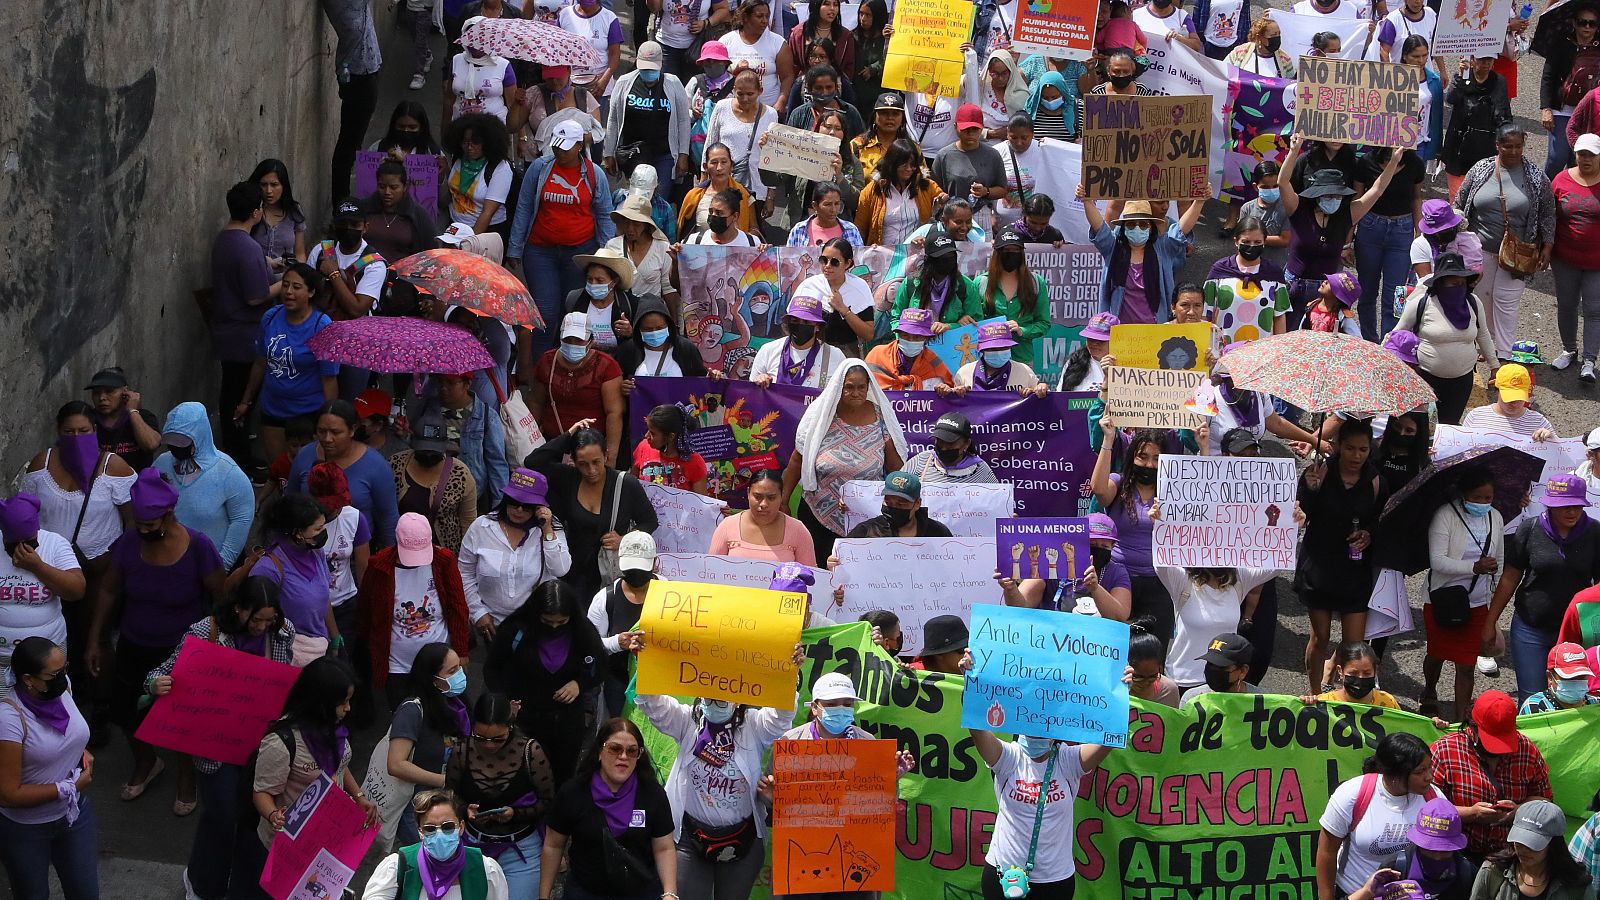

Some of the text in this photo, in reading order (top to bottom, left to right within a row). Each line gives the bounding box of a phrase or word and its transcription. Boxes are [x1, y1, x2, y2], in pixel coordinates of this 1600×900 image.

[943, 8, 954, 18] de
[919, 16, 946, 28] Integral
[1022, 18, 1060, 29] ¡CUMPLAN
[1061, 23, 1076, 31] CON
[1020, 34, 1069, 46] LAS MUJERES!
[1021, 26, 1089, 41] PRESUPUESTO PARA
[1146, 47, 1165, 58] rzo
[1149, 63, 1202, 86] de la Mujer
[1299, 57, 1328, 84] NO
[1335, 62, 1366, 85] HAY
[1317, 86, 1381, 113] BELLO
[1386, 92, 1419, 116] QUE
[1349, 113, 1419, 147] JUNTAS
[1083, 135, 1112, 163] HOY
[1115, 130, 1140, 164] NO
[1141, 128, 1171, 162] VOY
[1085, 163, 1207, 199] POR LA CALLE
[544, 191, 575, 204] PUMA
[1028, 252, 1104, 268] RANDO SOBE
[1060, 270, 1102, 285] Y SOLID
[1076, 285, 1100, 301] DER
[1064, 301, 1100, 319] DIGN
[1112, 367, 1205, 388] MARCHO HOY
[1113, 386, 1191, 402] con mis amigas
[1134, 399, 1180, 411] no marchar
[899, 420, 936, 434] eldía
[970, 421, 1045, 434] minamos
[1049, 419, 1063, 431] el
[1109, 409, 1203, 428] mañana POR ELLAS
[979, 440, 1046, 455] pesino y
[1557, 446, 1572, 455] que
[990, 456, 1074, 471] Soberanía
[1159, 459, 1296, 481] NO ESTOY ACEPTANDO
[843, 486, 980, 500] Este ecuerda que
[1001, 478, 1069, 492] nizamos
[1159, 481, 1296, 503] LAS COSAS QUE NO PUEDO
[951, 503, 988, 519] estamos
[1216, 504, 1260, 525] ESTOY
[1000, 524, 1085, 534] ¡NI UNA MENOS!
[1155, 524, 1294, 549] CAMBIANDO LAS COSAS
[893, 553, 908, 561] me
[916, 551, 955, 561] recuerda
[962, 554, 977, 566] que
[1156, 547, 1293, 568] QUE NO PUEDO ACEPTAR
[723, 572, 737, 581] me
[868, 572, 987, 592] muchas las que estamos
[0, 586, 52, 601] BRES
[660, 590, 712, 628] PAE
[900, 604, 915, 612] nos
[923, 599, 951, 612] faltan
[718, 614, 757, 639] para
[976, 617, 1120, 660] Ante la Violencia
[649, 627, 791, 673] todas es nuestro
[806, 636, 945, 713] tamos
[1001, 653, 1066, 682] Pobreza,
[1073, 662, 1088, 686] la
[679, 661, 762, 697] Derecho
[965, 675, 1108, 711] Mujeres queremos
[1015, 706, 1104, 732] Respuestas
[1180, 694, 1386, 754] de todas
[776, 740, 849, 756] NO ES UN
[774, 755, 857, 772] GOBIERNO
[853, 770, 886, 783] hasta
[707, 775, 740, 797] PAE
[798, 783, 825, 798] paren
[829, 781, 841, 791] de
[818, 792, 840, 805] Van
[1009, 790, 1065, 805] LIDERMOS
[849, 815, 871, 825] hacen
[1124, 835, 1317, 885] ALTO AL
